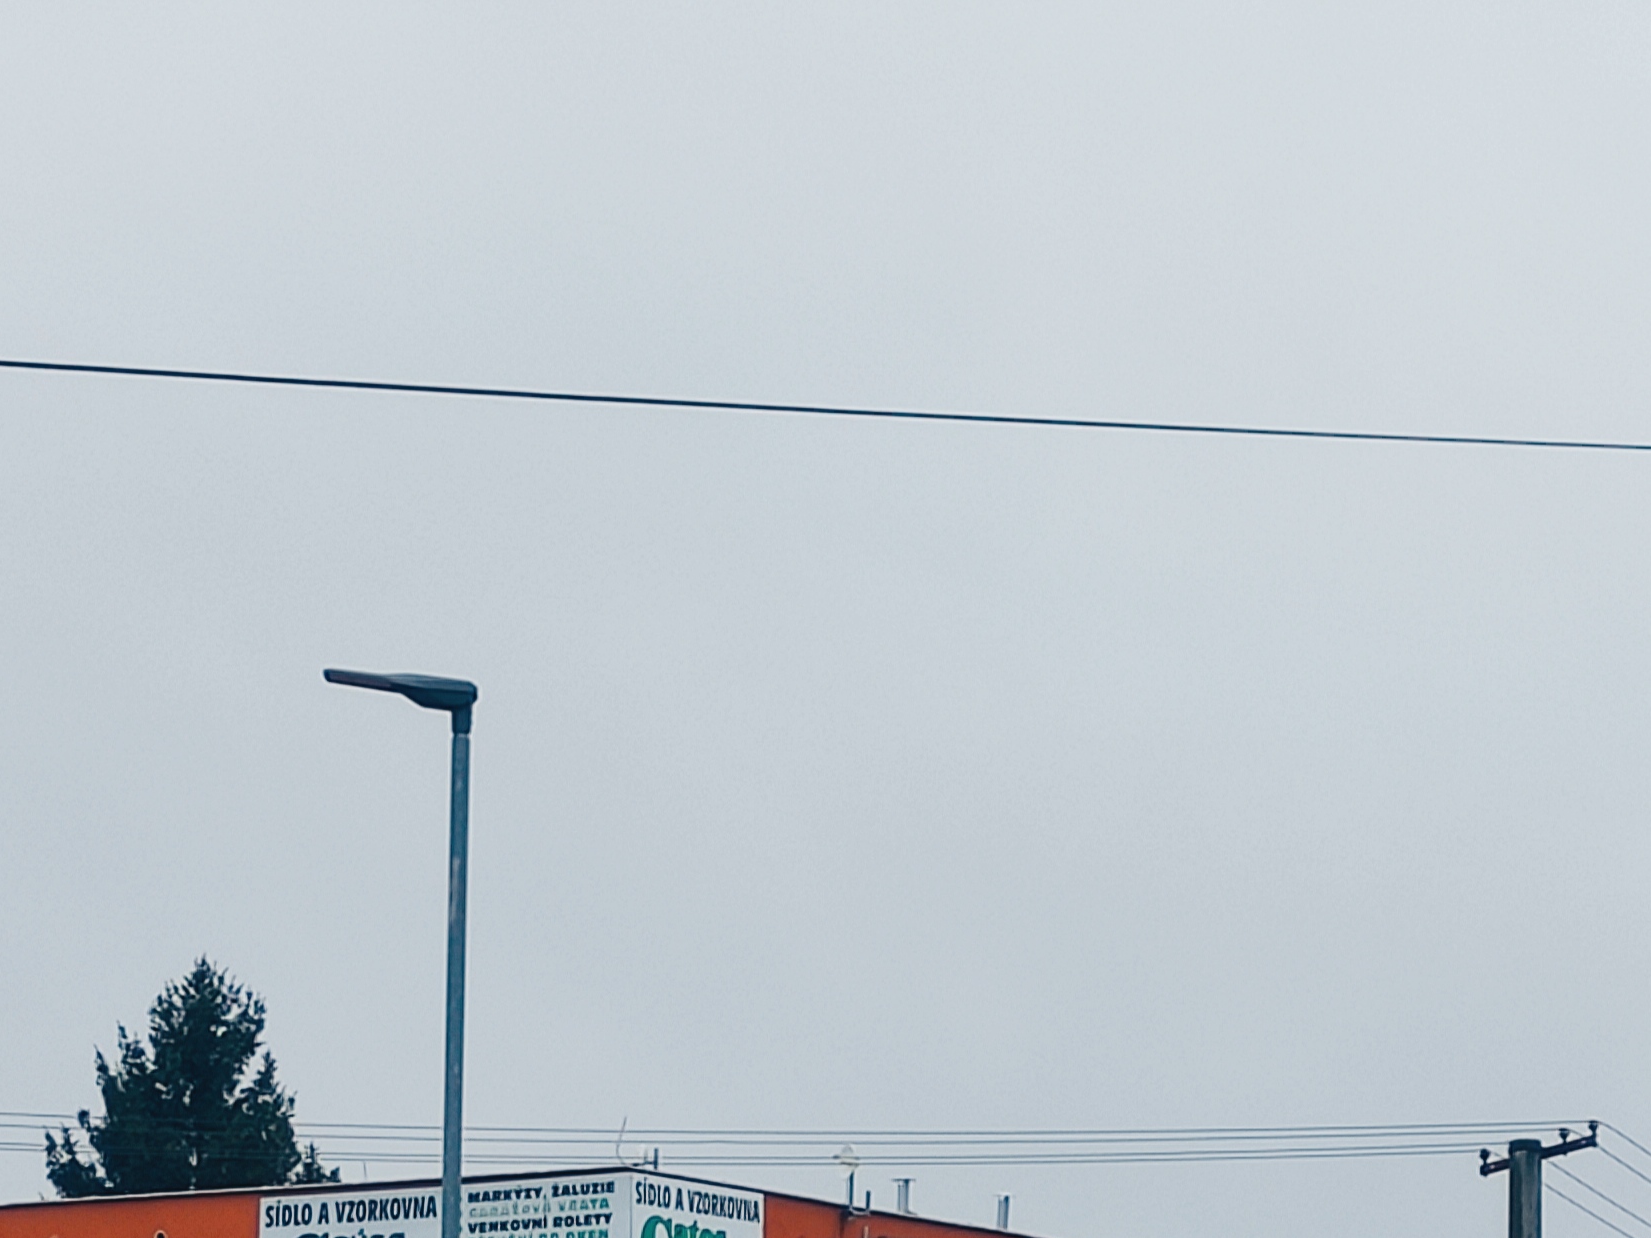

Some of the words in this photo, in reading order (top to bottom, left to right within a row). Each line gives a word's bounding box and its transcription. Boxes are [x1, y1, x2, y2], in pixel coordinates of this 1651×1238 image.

[551, 1181, 615, 1198] ŽALUZIE
[635, 1177, 671, 1208] SÍDLO
[675, 1188, 684, 1211] A
[687, 1190, 760, 1223] VZORKOVNA
[265, 1200, 313, 1228] SÍDLO
[318, 1202, 329, 1225] A
[335, 1195, 437, 1223] VZORKOVNA
[467, 1214, 548, 1234] VENKOVNÍ
[553, 1212, 613, 1229] ROLETY
